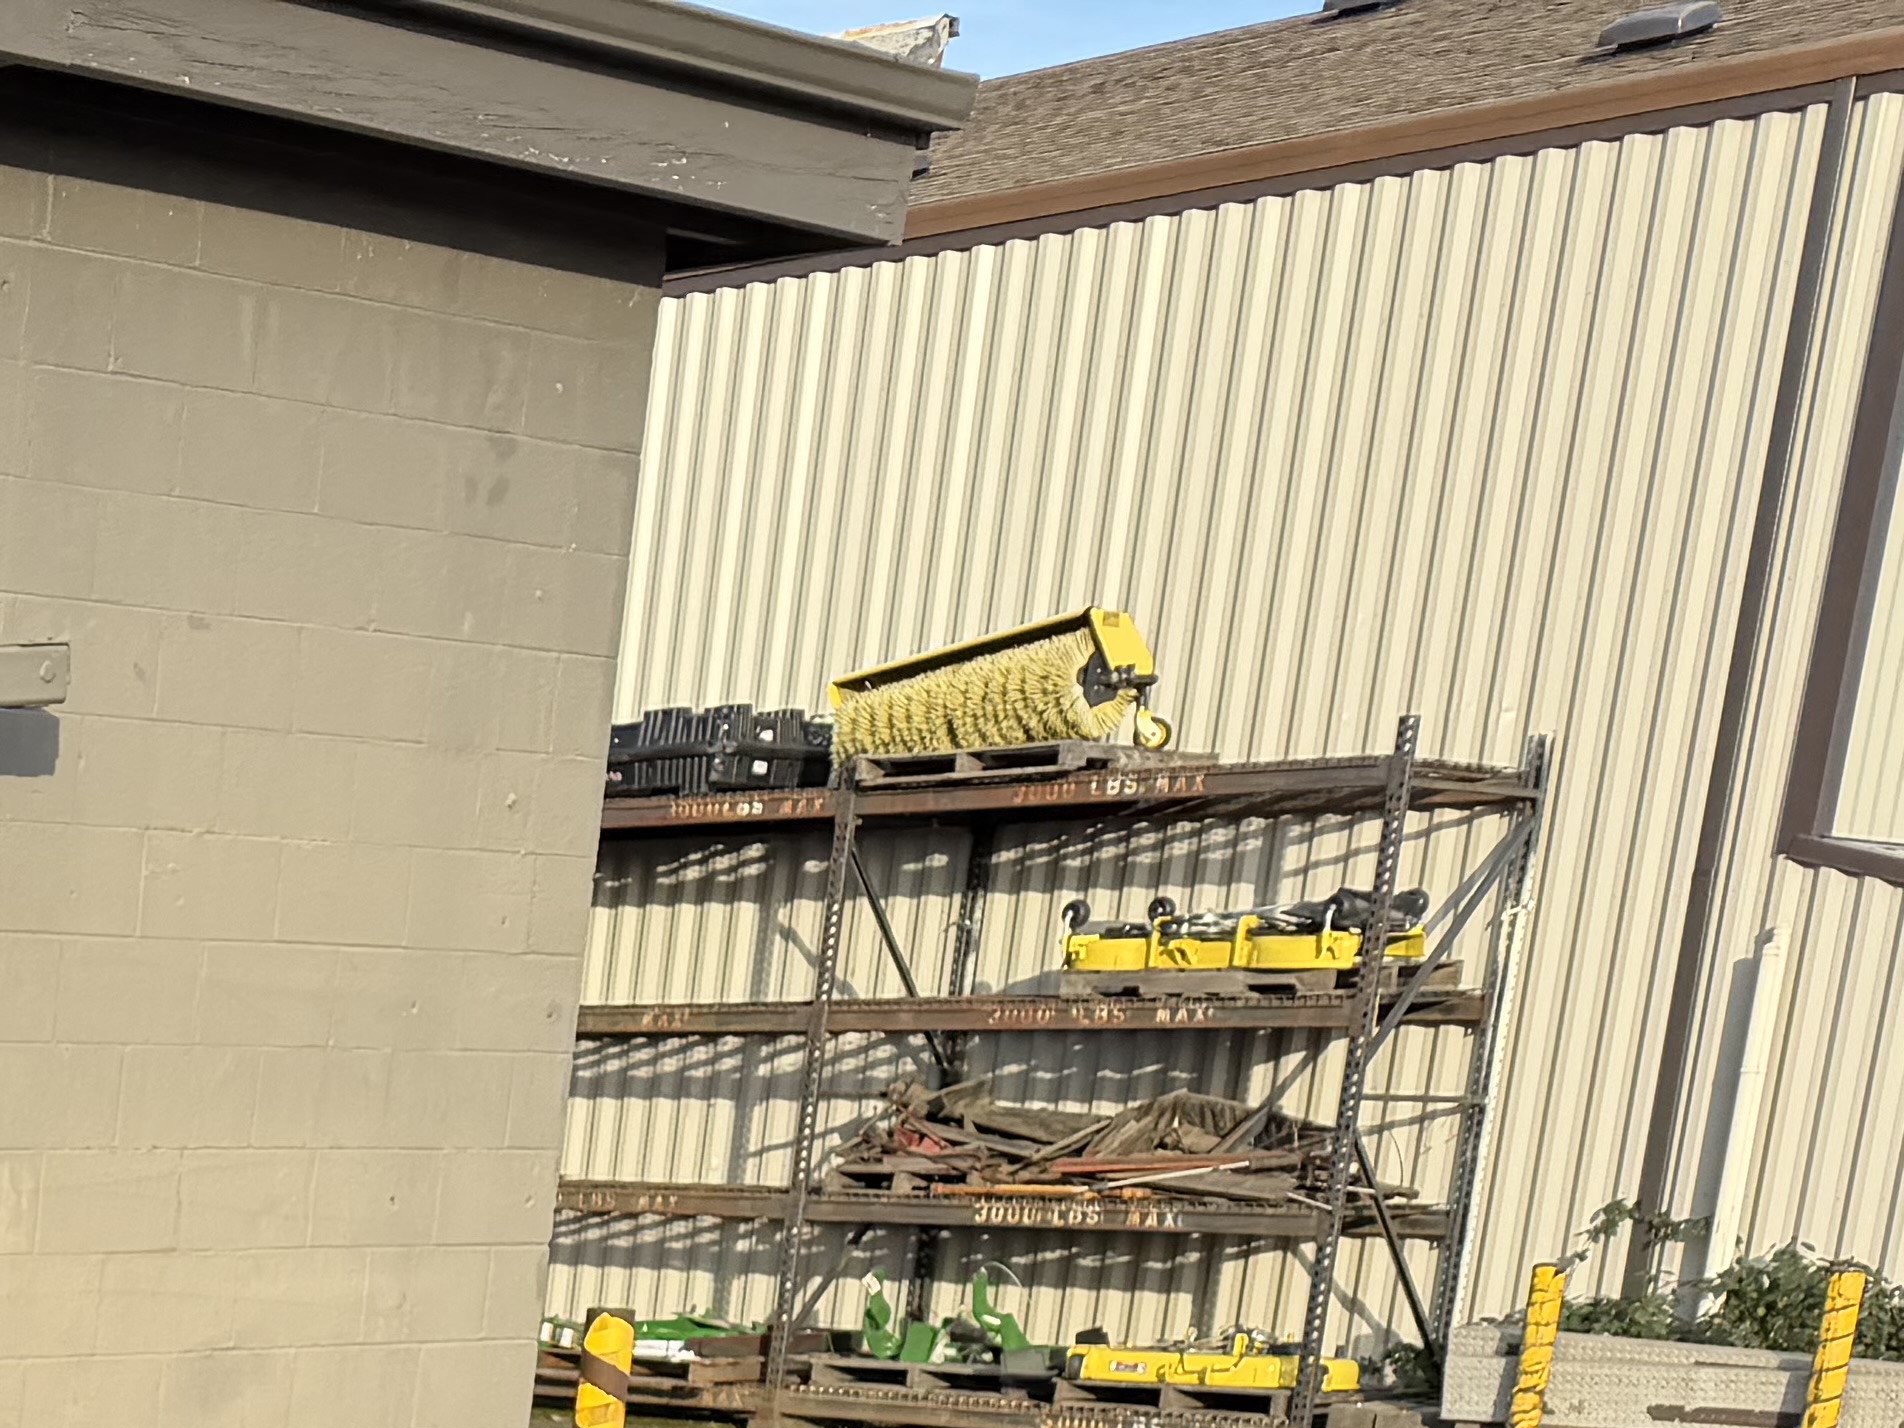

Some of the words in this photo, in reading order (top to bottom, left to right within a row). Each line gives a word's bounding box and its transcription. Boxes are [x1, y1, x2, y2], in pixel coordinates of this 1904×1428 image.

[1089, 773, 1138, 797] LBS
[1155, 773, 1205, 794] MAX
[1155, 1004, 1210, 1025] MAX
[974, 1203, 1038, 1224] 3000
[1051, 1204, 1102, 1227] LBS
[1126, 1208, 1177, 1229] MAX
